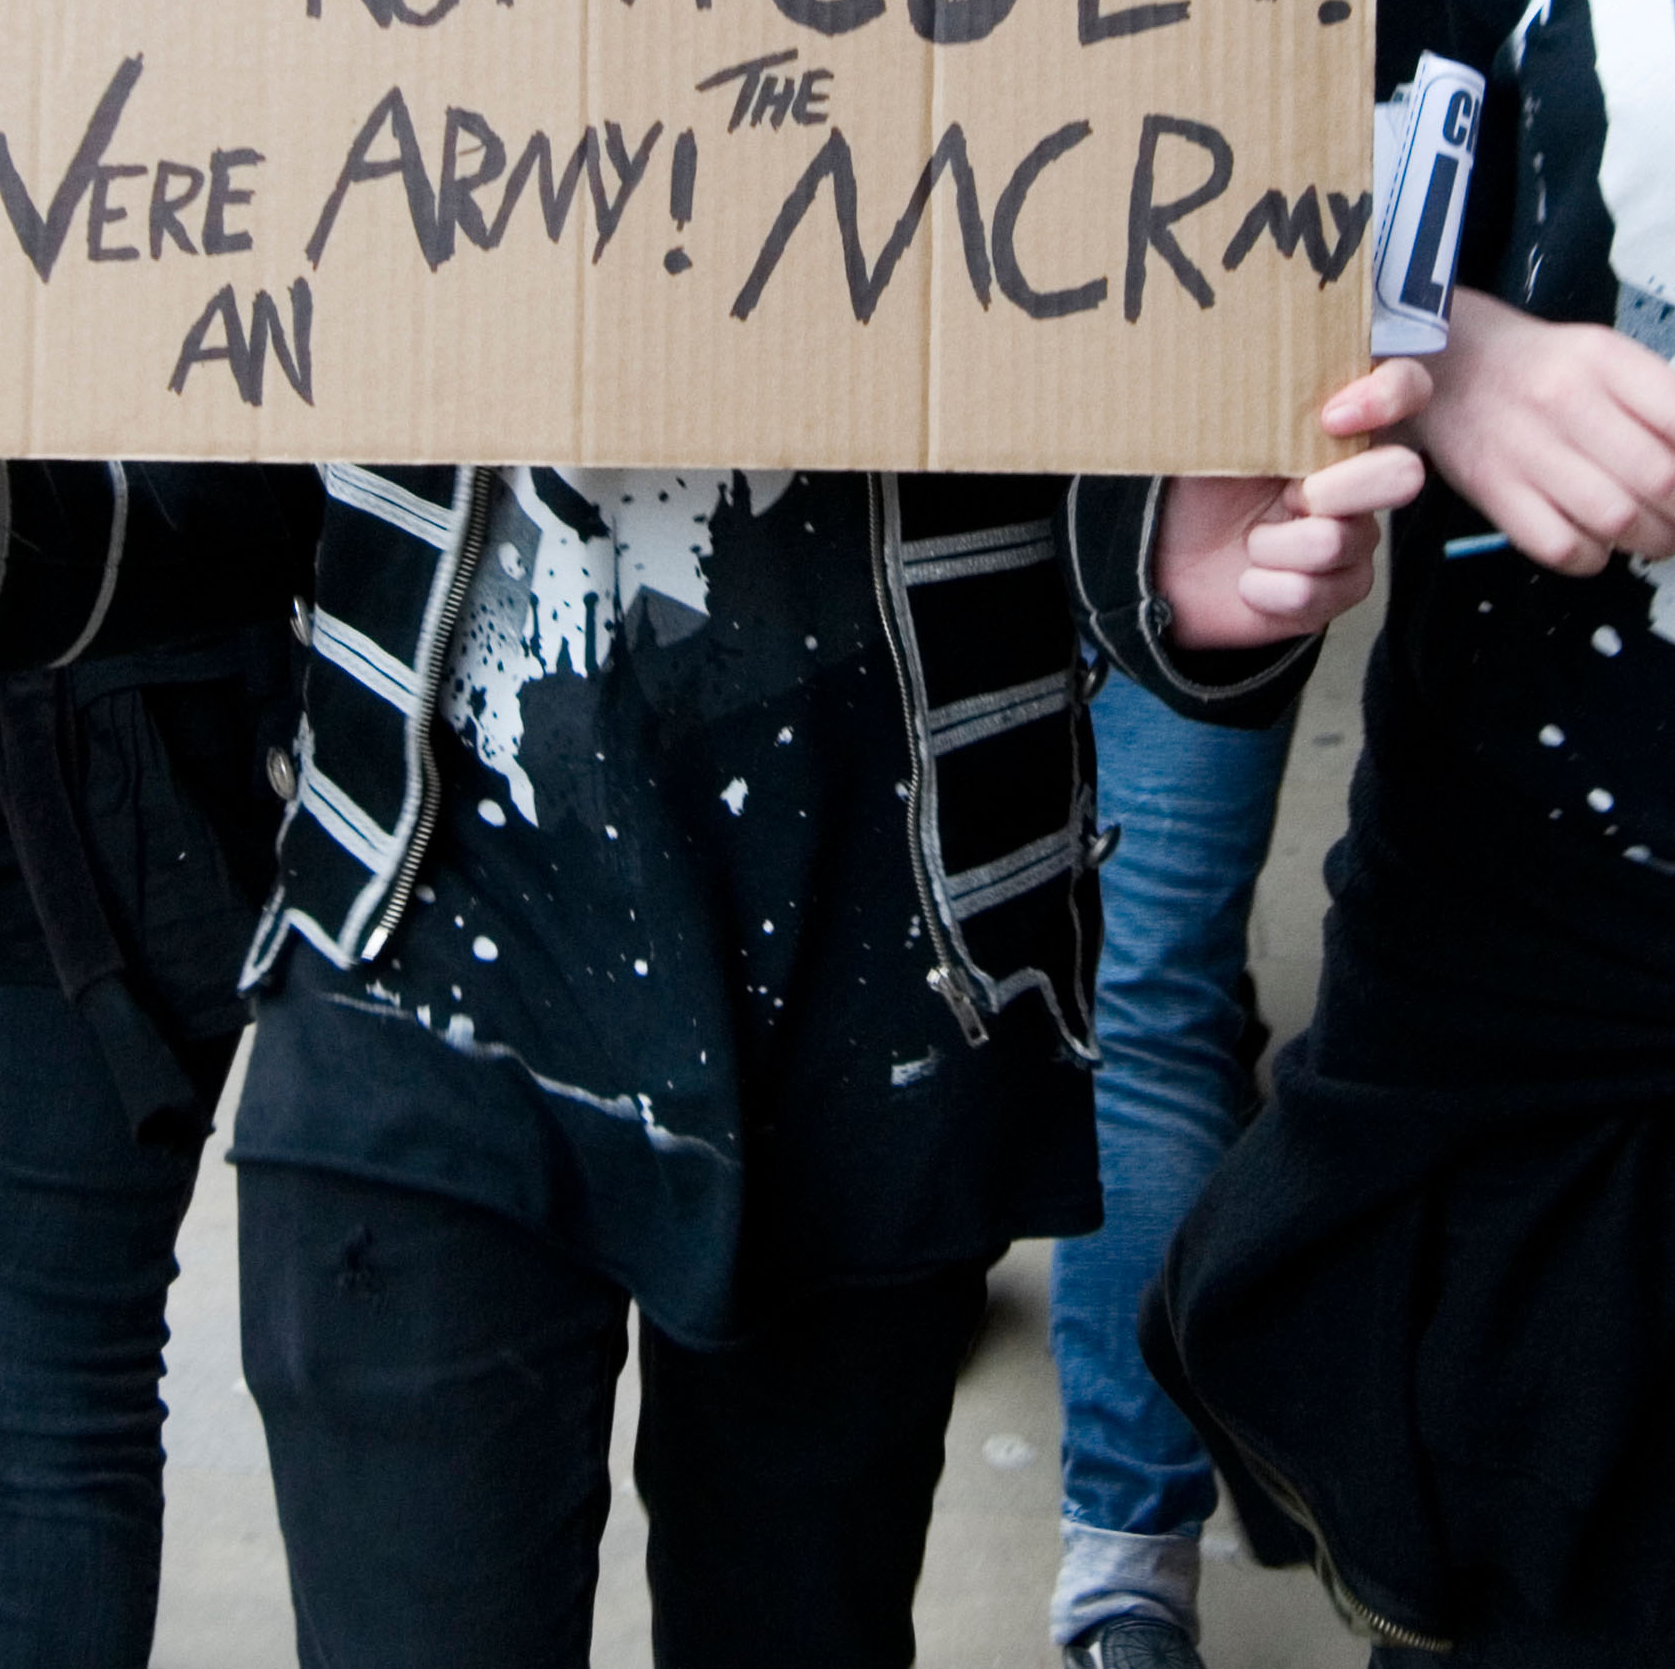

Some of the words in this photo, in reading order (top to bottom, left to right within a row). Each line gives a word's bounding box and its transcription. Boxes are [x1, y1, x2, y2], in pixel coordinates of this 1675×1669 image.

[306, 86, 699, 275] ARMY!
[695, 49, 832, 129] THE
[169, 279, 314, 408] AN
